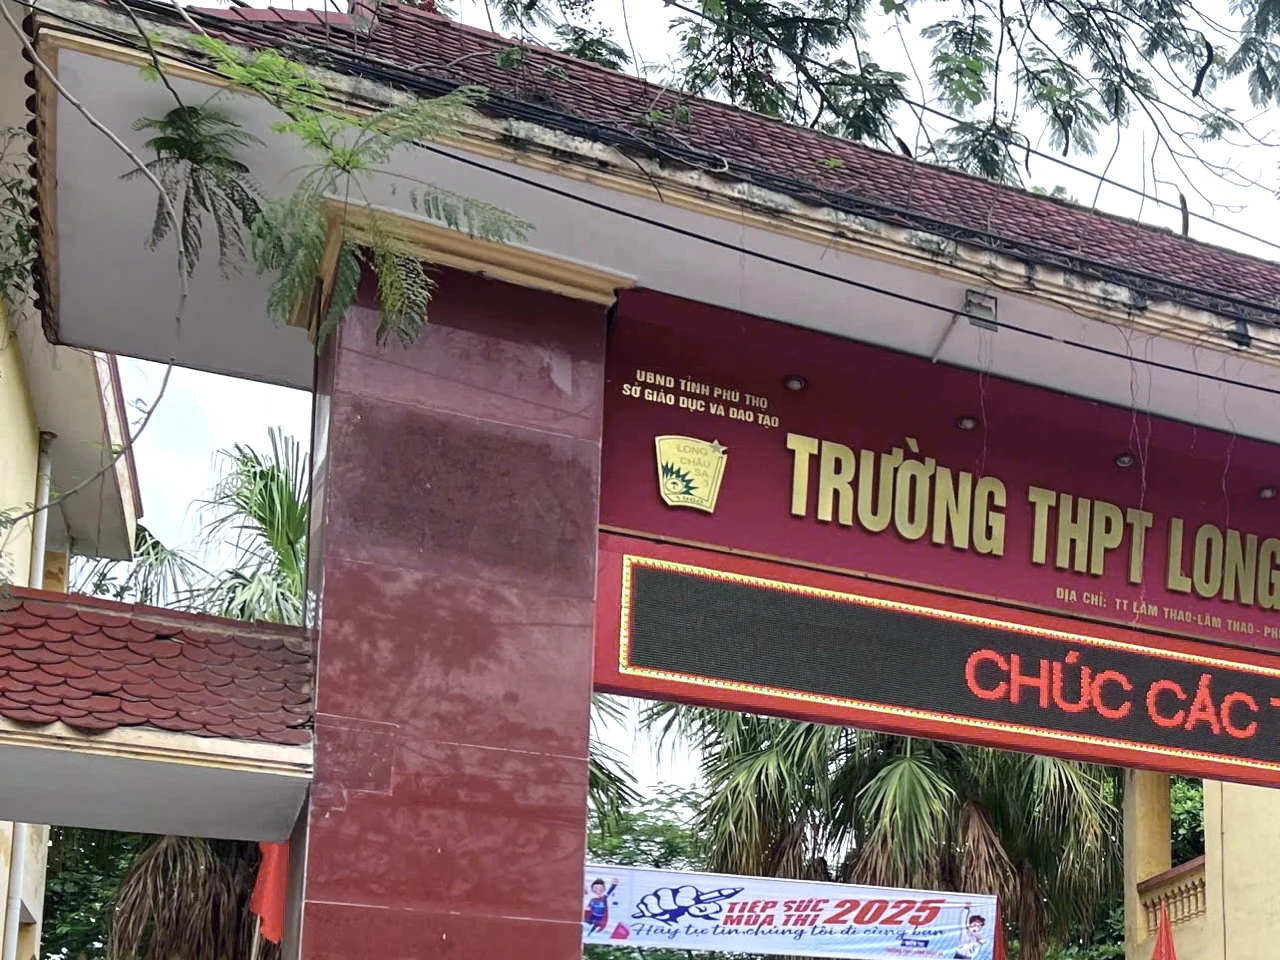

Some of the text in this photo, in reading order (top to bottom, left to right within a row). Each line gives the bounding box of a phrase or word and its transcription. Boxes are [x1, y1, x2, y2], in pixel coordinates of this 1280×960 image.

[621, 381, 641, 398] SỞ
[644, 388, 675, 406] GIÁO
[679, 396, 705, 412] DỤC
[709, 402, 725, 416] VÀ
[757, 413, 780, 429] TẠO
[636, 369, 674, 388] UBND
[744, 394, 769, 411] THỌ
[676, 444, 708, 455] LONG
[786, 432, 1007, 557] TRƯỜNG
[1027, 485, 1154, 585] THPT
[1115, 598, 1129, 612] TT
[1227, 618, 1255, 634] THAO
[965, 650, 1133, 720] CHÚC
[1146, 673, 1259, 740] CÁC
[781, 914, 820, 926] THI
[823, 899, 946, 925] 2025
[631, 923, 681, 939] Hãy
[810, 924, 839, 936] tôi
[840, 924, 860, 935] đi
[863, 926, 910, 940] cùng
